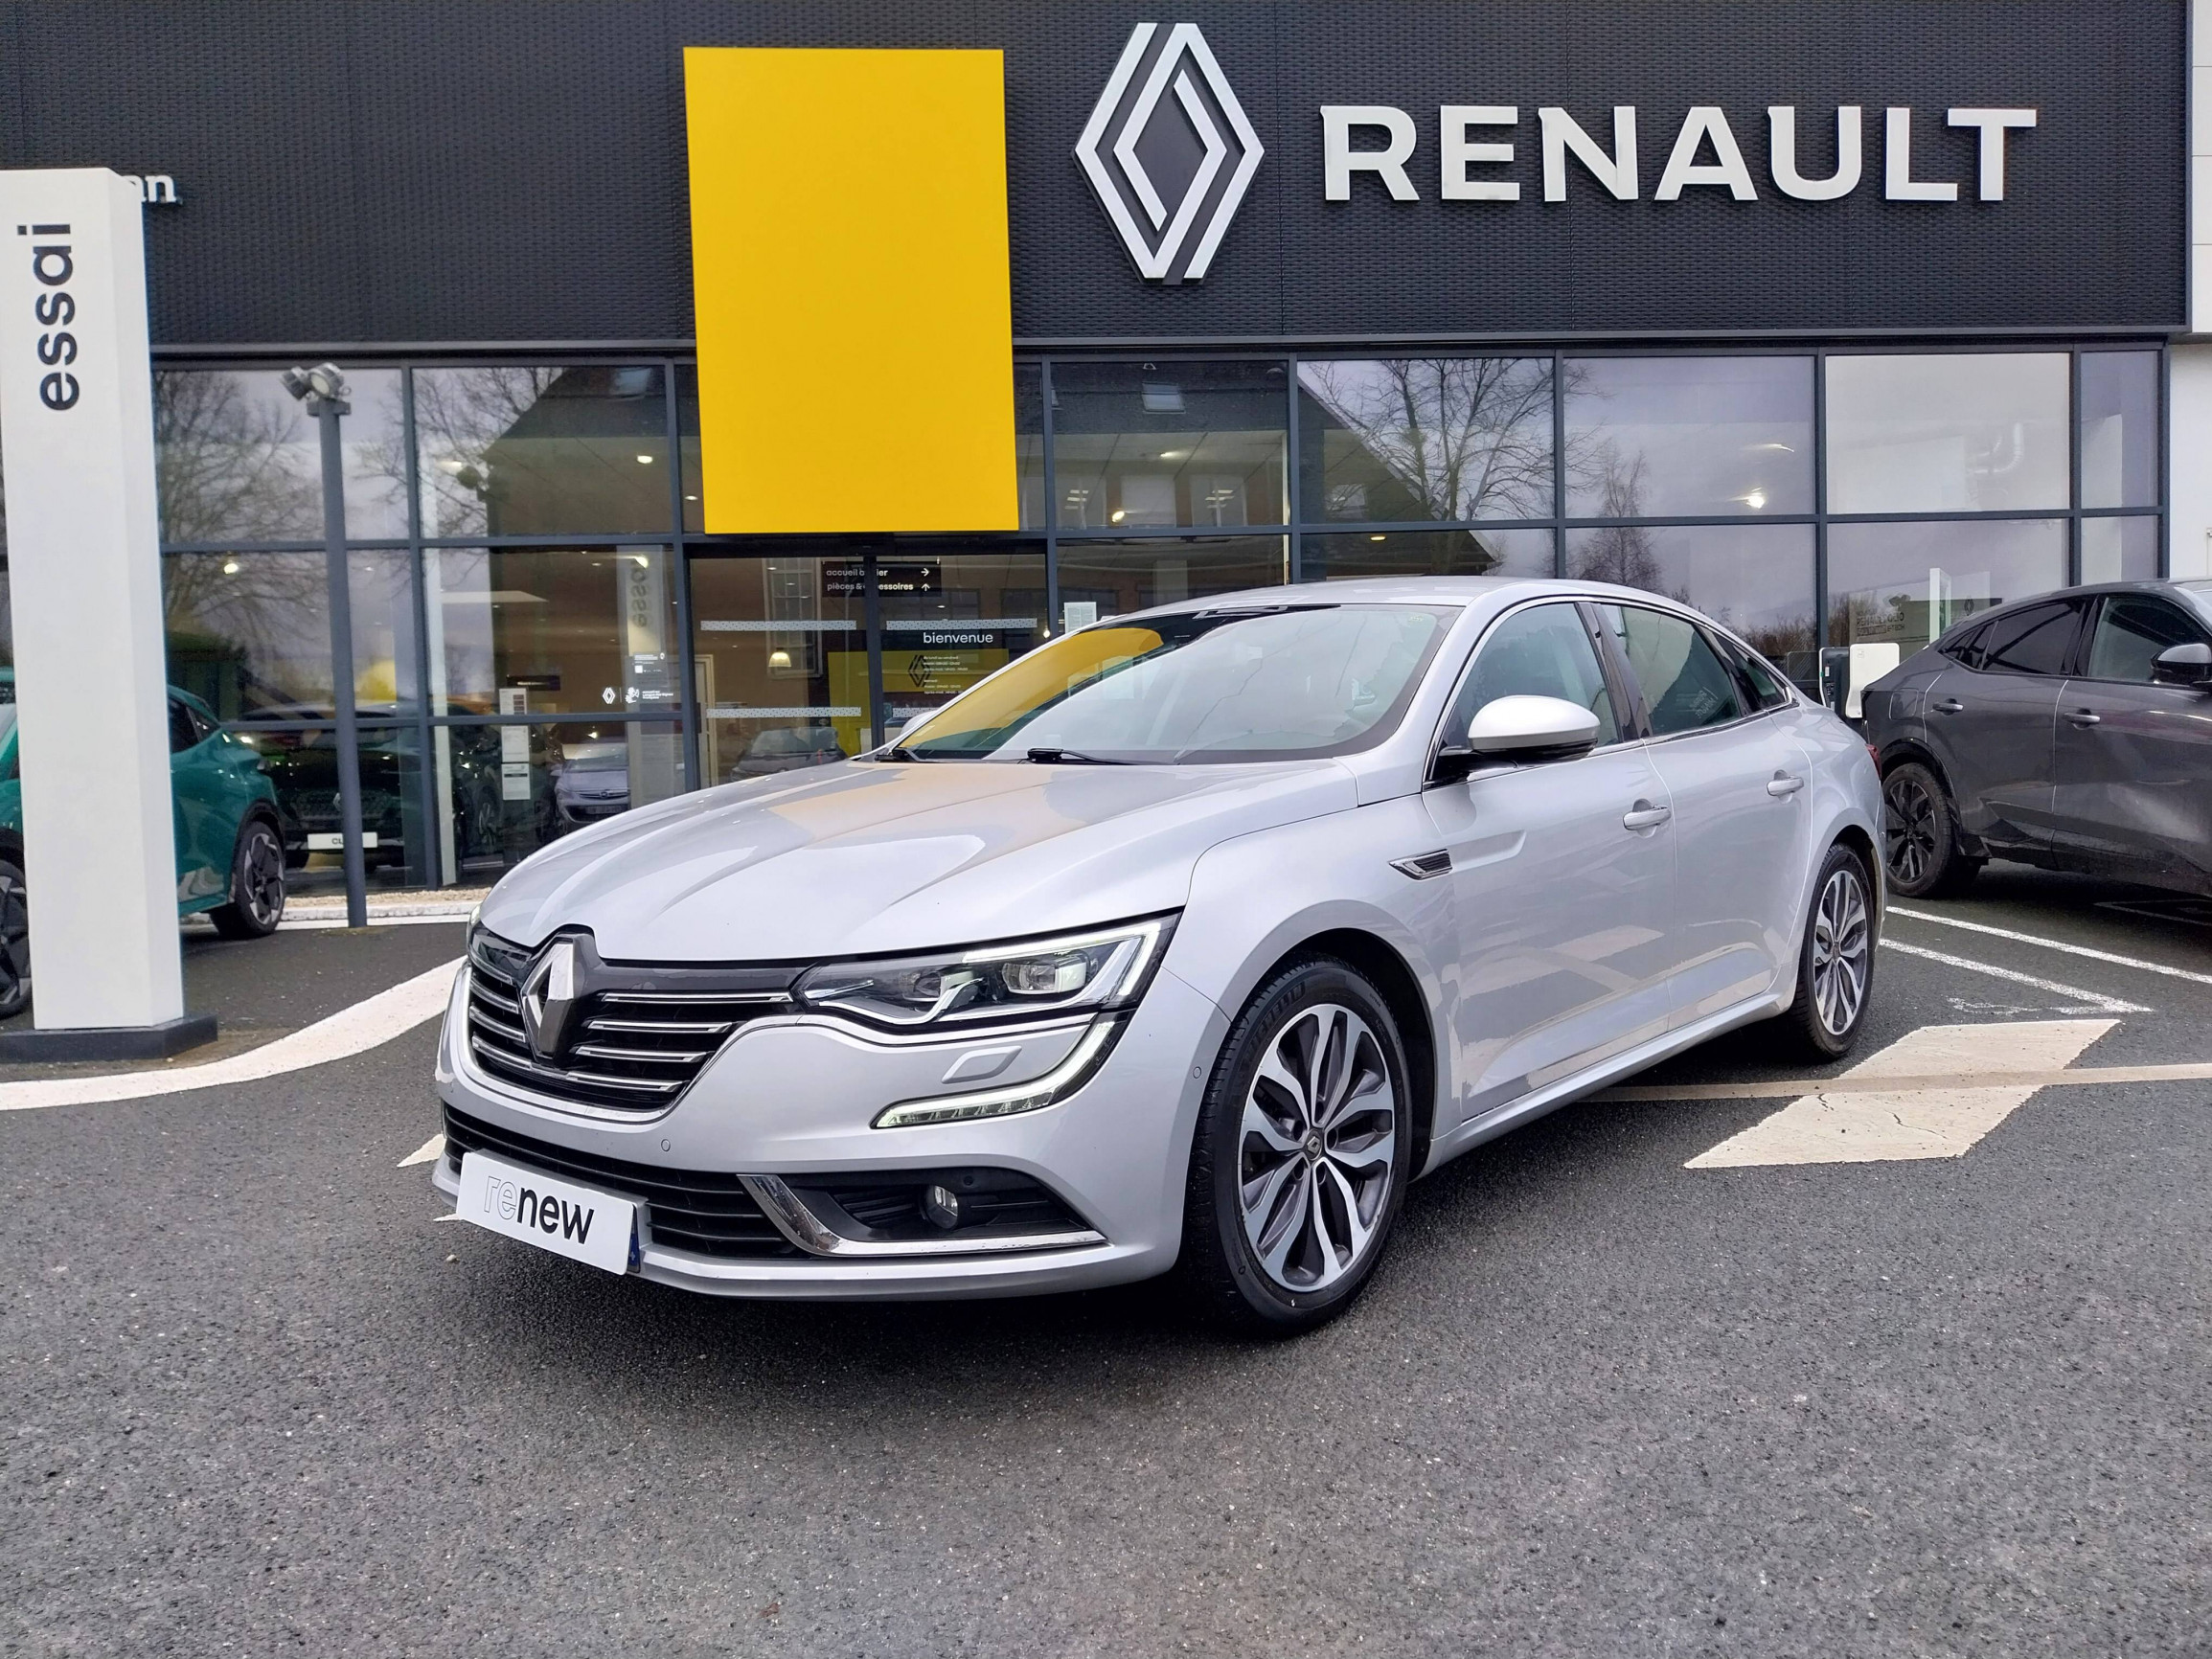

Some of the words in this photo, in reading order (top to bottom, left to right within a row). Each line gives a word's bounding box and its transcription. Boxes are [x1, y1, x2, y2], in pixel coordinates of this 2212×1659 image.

[1319, 104, 2038, 203] RENAULT
[17, 224, 80, 411] essai
[826, 568, 858, 577] accueil
[827, 582, 855, 592] pièces
[923, 632, 993, 644] bienvenue
[484, 1175, 595, 1244] renew
